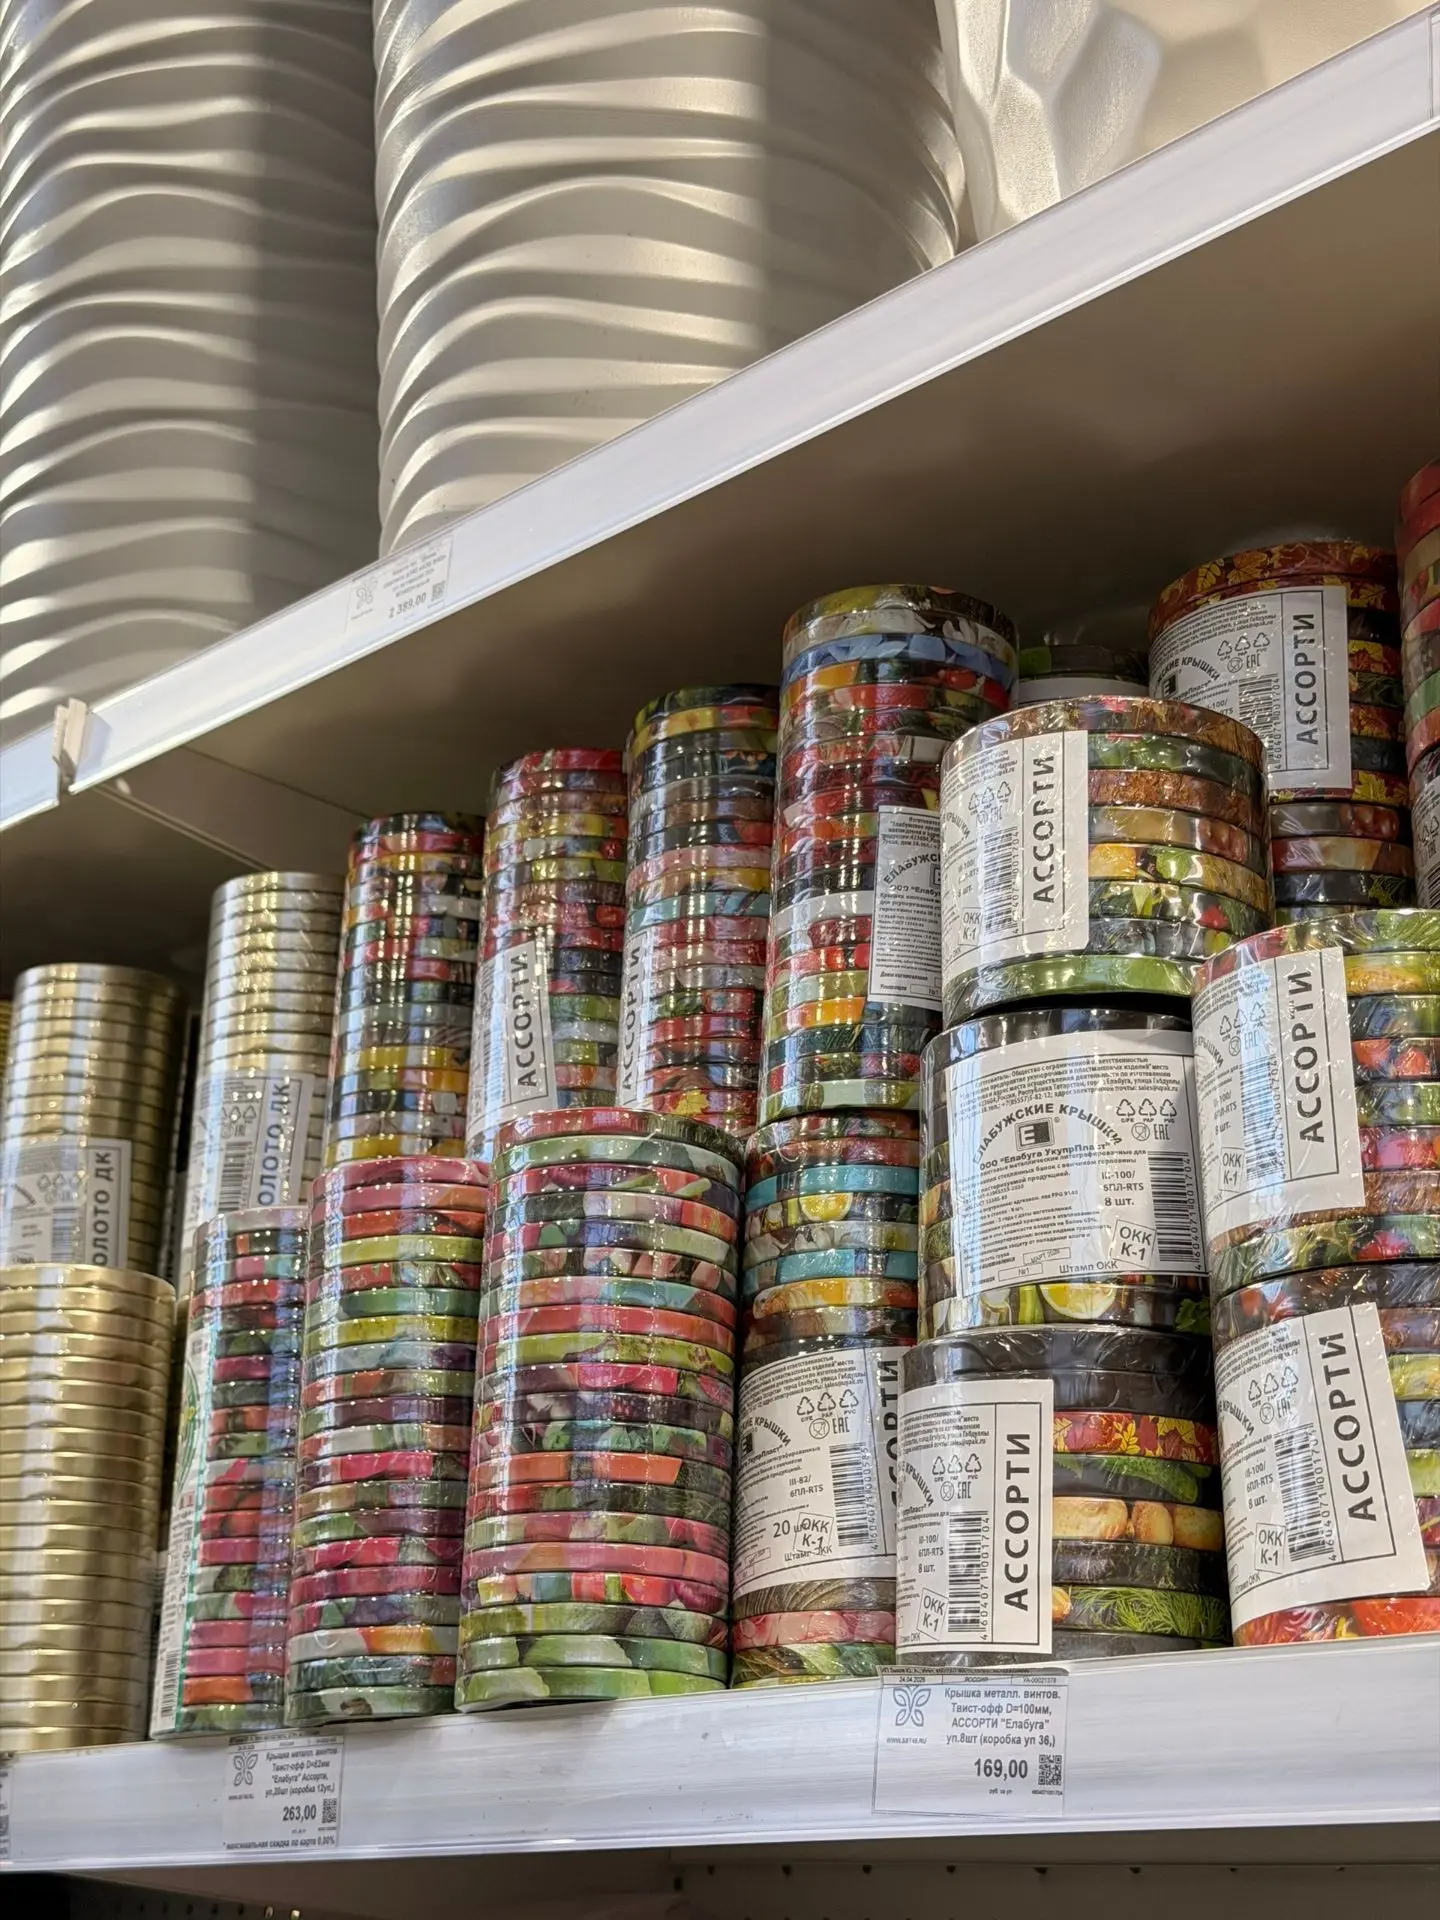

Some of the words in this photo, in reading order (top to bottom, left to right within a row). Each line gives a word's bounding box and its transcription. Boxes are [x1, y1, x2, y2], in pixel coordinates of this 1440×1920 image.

[1182, 656, 1220, 680] КРЫШКИ
[1293, 614, 1318, 744] АССОРТИ
[1033, 756, 1054, 904] АССОРТИ
[884, 854, 940, 884] ЕЛАБУЖС
[963, 910, 980, 924] ОКК
[962, 926, 976, 940] К-1
[510, 952, 537, 1088] АССОРТИ
[622, 946, 640, 1090] АССОРТИ
[1288, 972, 1324, 1143] АССОРТИ
[1059, 1104, 1122, 1145] КРЫШКИ
[258, 1124, 284, 1206] ОЛОТО
[271, 1084, 291, 1115] ДК
[95, 1152, 114, 1182] ДК
[980, 1160, 998, 1170] ООО
[1222, 1152, 1242, 1167] ОКК
[1184, 1158, 1196, 1205] 001704
[1224, 1170, 1238, 1186] К-1
[1104, 1197, 1112, 1206] 8
[1115, 1197, 1134, 1206] шт.
[92, 1190, 110, 1267] ОЛОТО
[1119, 1226, 1152, 1246] ОКК
[1188, 1211, 1200, 1258] 604071
[1120, 1242, 1146, 1261] К-1
[1059, 1263, 1094, 1274] Штамп
[1096, 1261, 1118, 1270] ОКК
[754, 1416, 791, 1446] КРЫШКИ
[1318, 1332, 1377, 1522] АССОРТИ
[789, 1474, 812, 1486] III-82/
[906, 1462, 934, 1506] КРЫШКИ
[1254, 1495, 1267, 1507] шт.
[773, 1520, 790, 1538] 20
[800, 1518, 829, 1534] ОКК
[1004, 1434, 1030, 1612] АССОРТИ
[802, 1533, 824, 1548] К-1
[980, 1518, 990, 1568] 001704
[1258, 1529, 1283, 1547] ОКК
[1260, 1548, 1278, 1566] К-1
[923, 1564, 936, 1573] шт.
[923, 1595, 945, 1615] ОКК
[980, 1576, 989, 1626] 604071
[923, 1613, 938, 1632] К-1
[944, 1688, 981, 1700] Крышка
[984, 1689, 1021, 1699] металл.
[1024, 1690, 1061, 1699] винтов.
[951, 1702, 1003, 1716] Твист-офф
[1006, 1703, 1052, 1716] D=100мм,
[952, 1717, 998, 1729] АССОРТИ
[1001, 1718, 1049, 1731] "Елабуга"
[946, 1734, 977, 1746] уп.8шт
[980, 1734, 1022, 1746] (коробка
[1024, 1737, 1036, 1747] уп
[974, 1758, 1028, 1780] 169,00
[283, 1804, 316, 1822] 263,00
